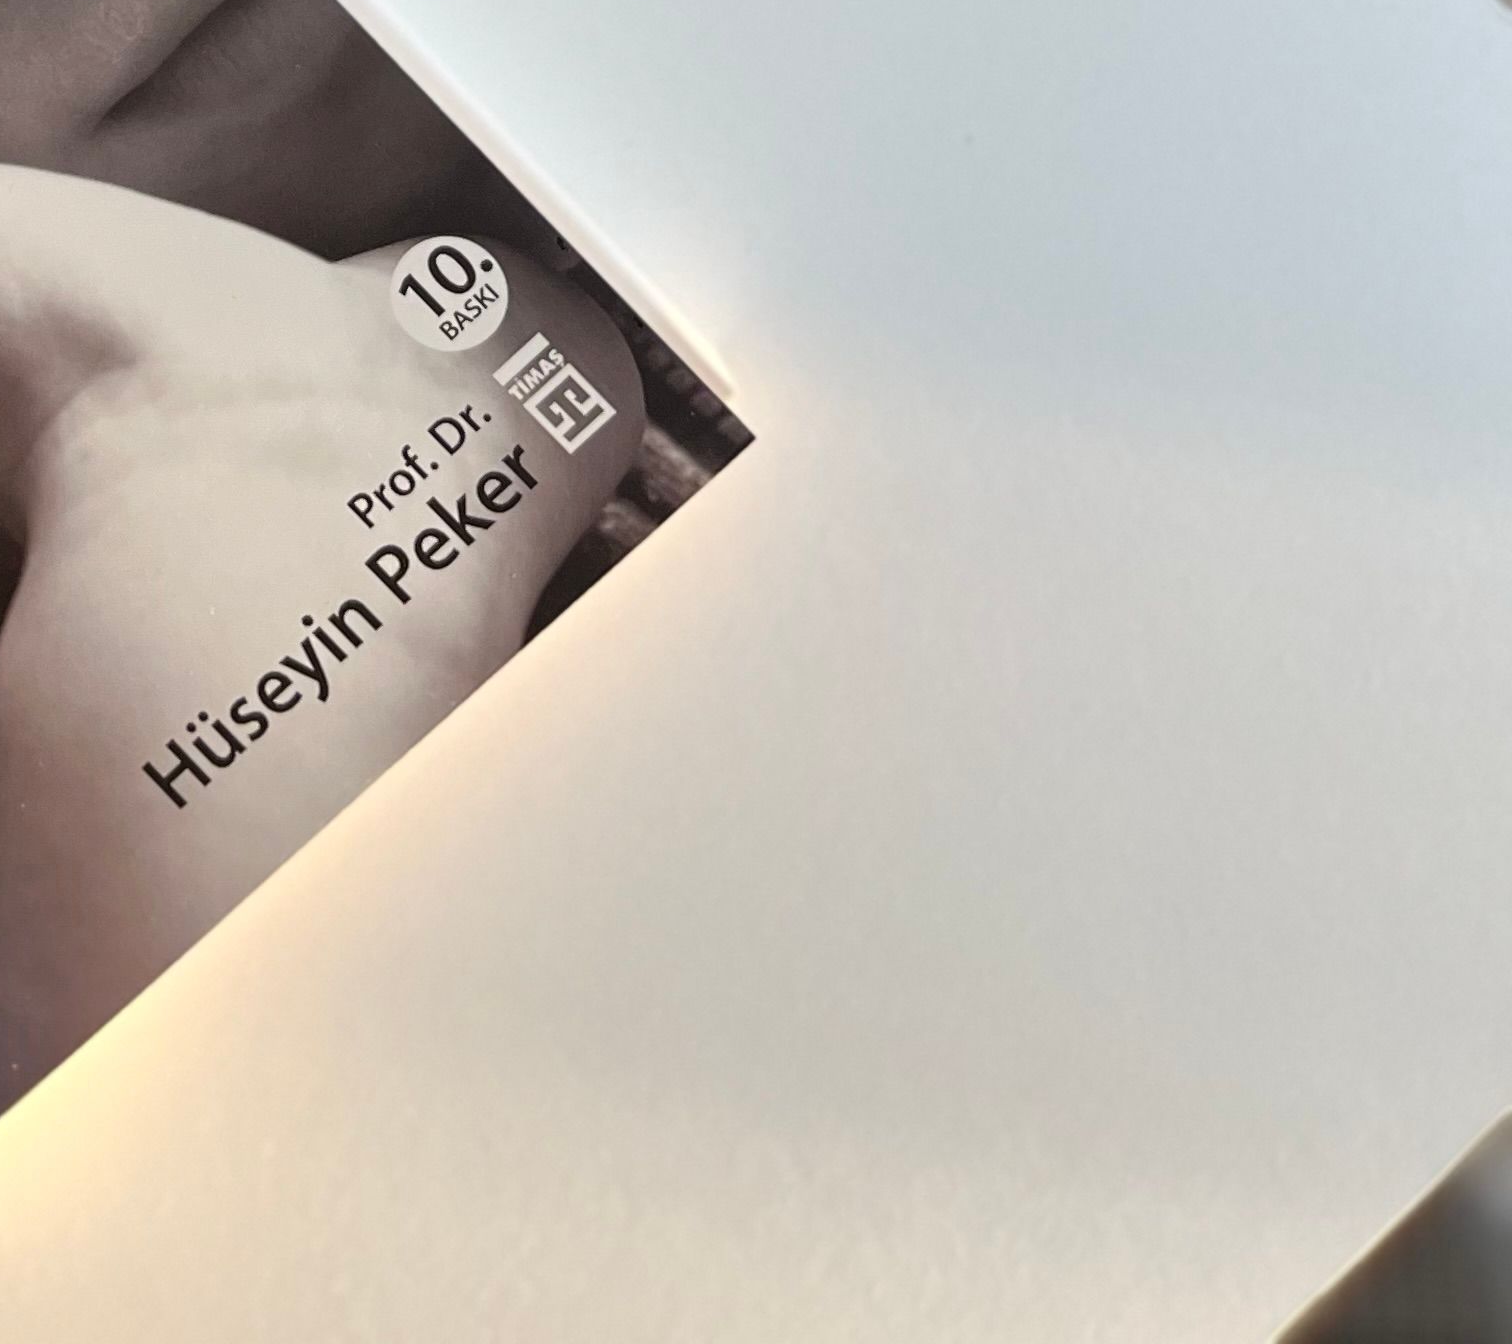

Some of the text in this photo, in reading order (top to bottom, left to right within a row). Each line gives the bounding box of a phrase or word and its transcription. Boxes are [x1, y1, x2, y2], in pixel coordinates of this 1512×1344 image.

[398, 244, 494, 318] 10.
[438, 282, 501, 341] BASKI
[507, 347, 565, 401] TİMAŞ
[346, 403, 492, 529] Prof. Dr.
[141, 443, 539, 809] Hüseyin Peker
